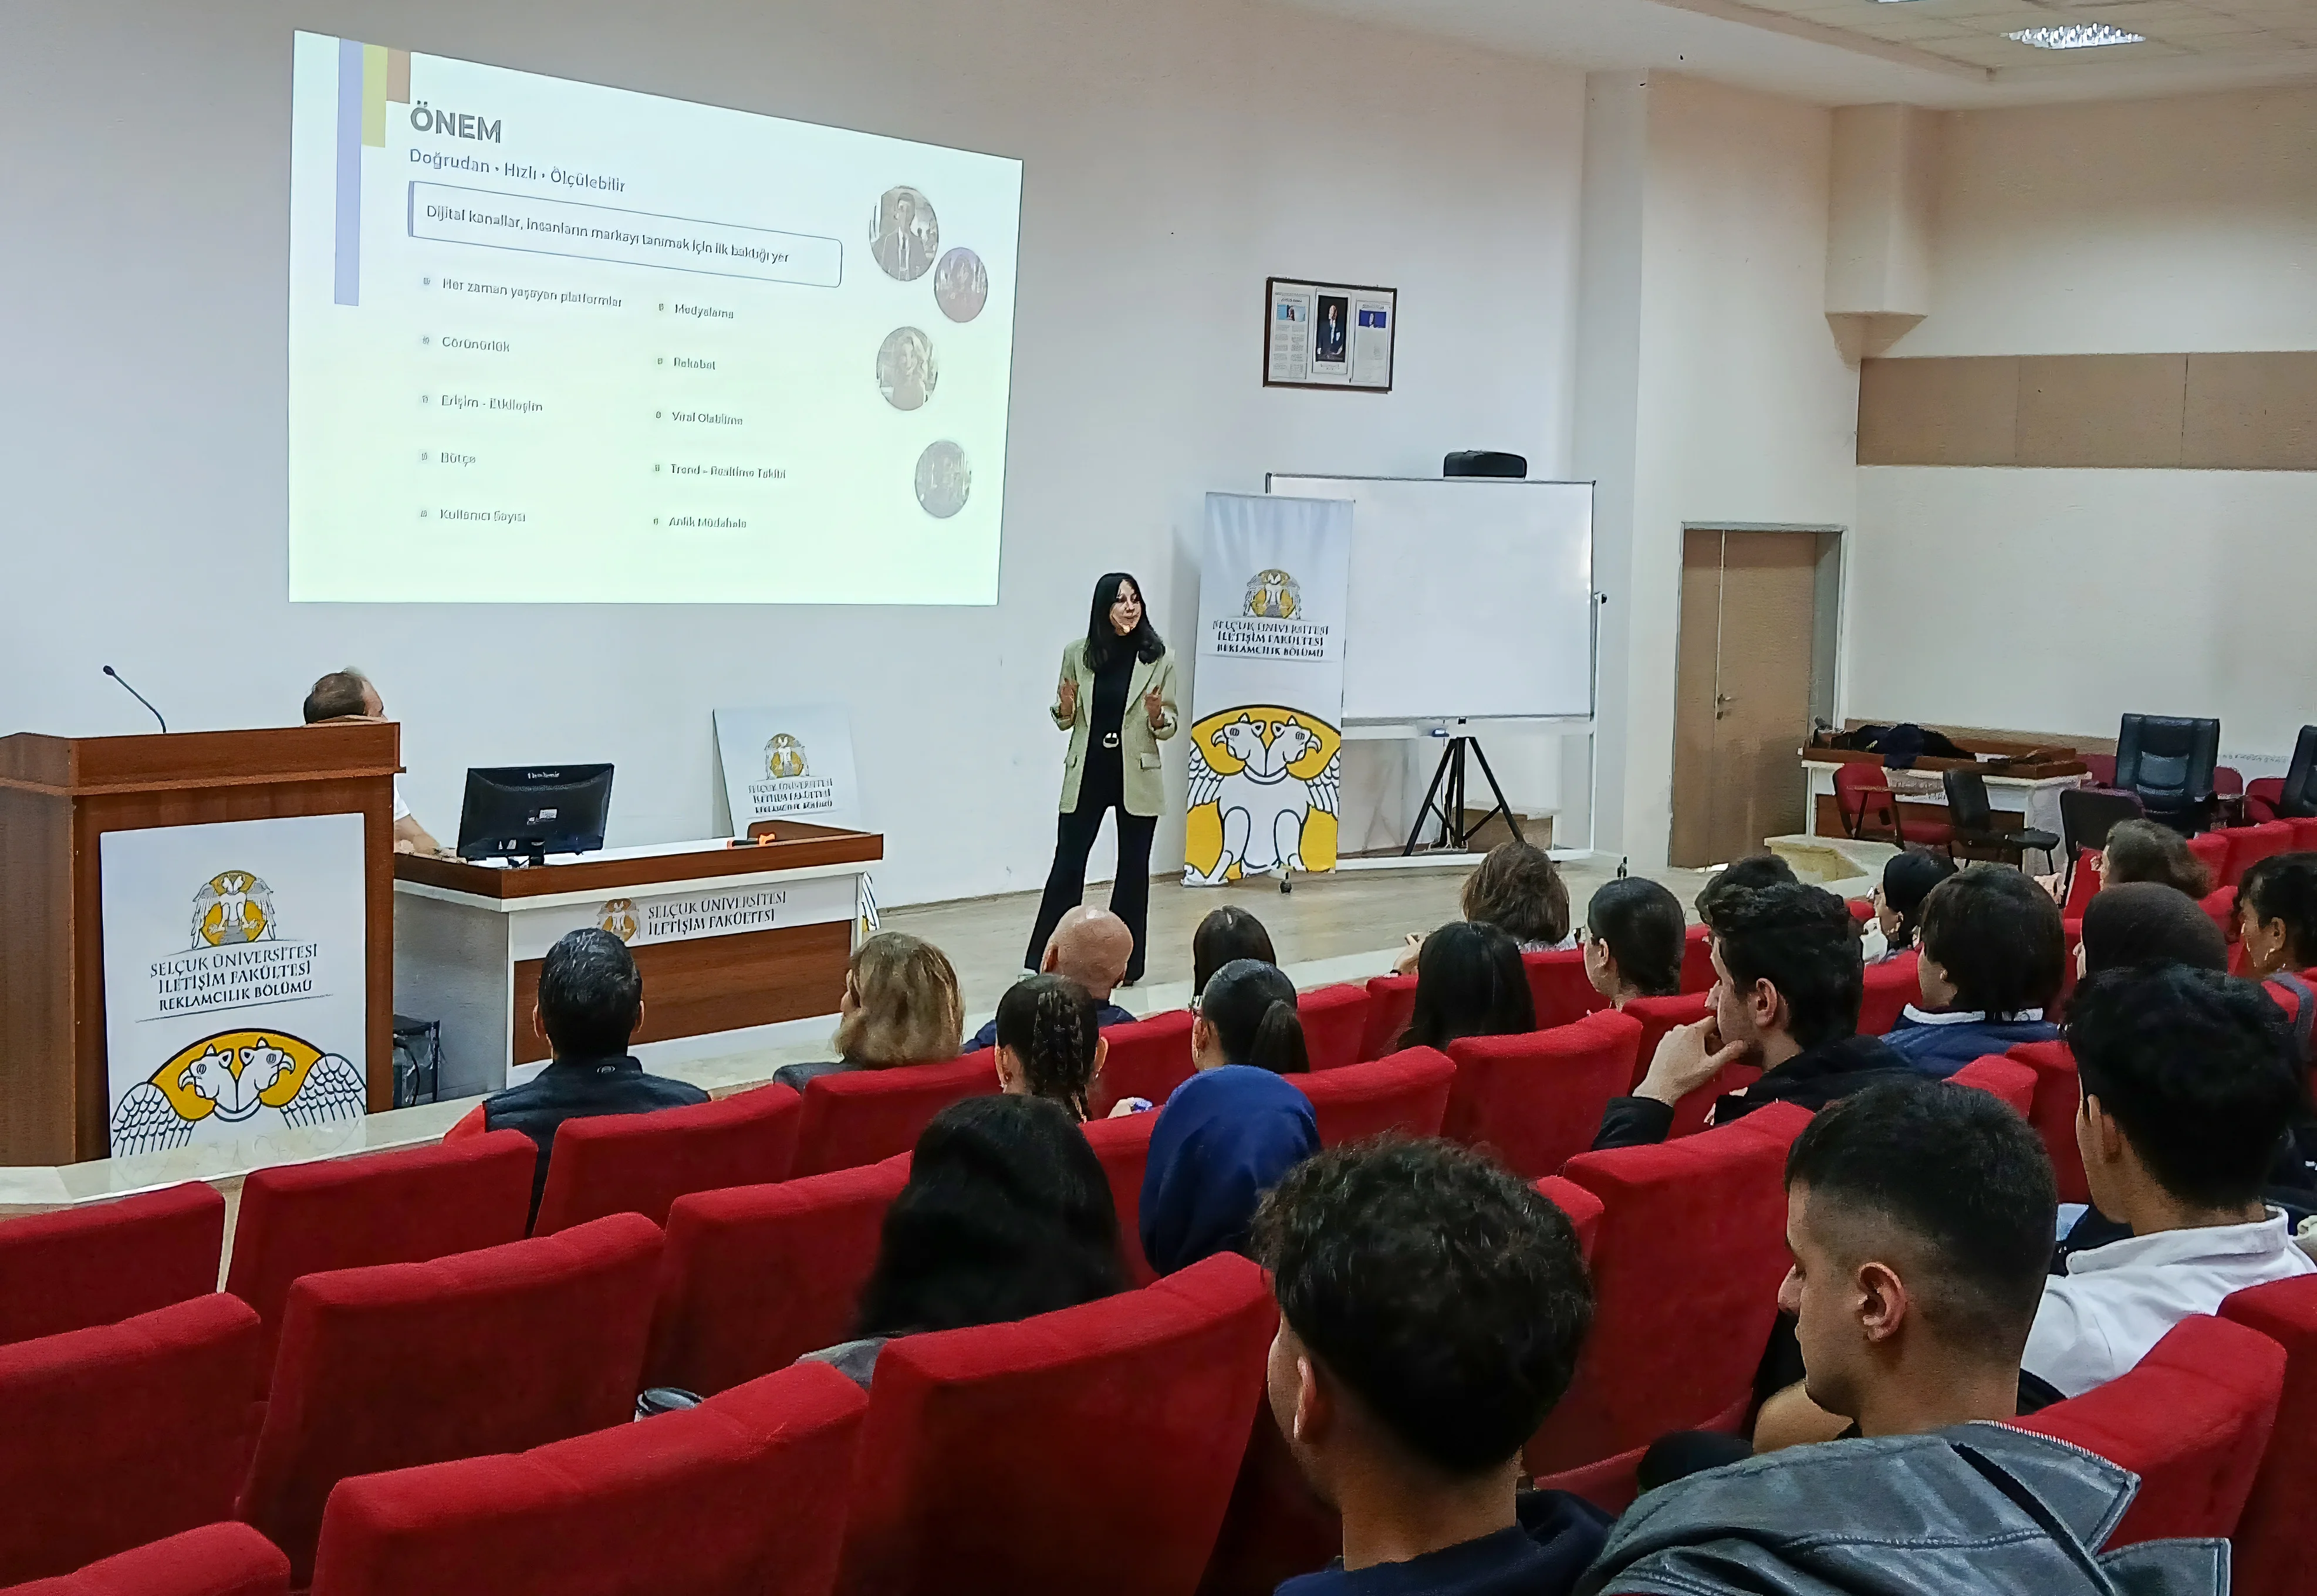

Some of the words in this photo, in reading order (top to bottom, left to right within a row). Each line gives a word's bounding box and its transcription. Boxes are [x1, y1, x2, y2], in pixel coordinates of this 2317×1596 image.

[410, 99, 501, 144] ÖNEM
[410, 148, 489, 173] Doğrudan
[504, 161, 536, 180] Hızlı
[550, 165, 626, 192] Ölçülebilir
[427, 205, 465, 222] Dijital
[469, 209, 523, 231] kanallar,
[591, 229, 639, 245] markayı
[642, 234, 690, 251] tanımak
[692, 239, 712, 255] için
[771, 252, 789, 265] yer
[467, 283, 508, 296] zaman
[560, 291, 622, 307] platformlar
[648, 902, 697, 919] SELÇUK
[649, 917, 705, 935] İLETİŞİM
[150, 956, 208, 978] SELÇUK
[212, 943, 318, 968] ÜNİVERSİTESİ
[158, 972, 225, 994] İLETİŞİM
[230, 960, 310, 985] FAKÜLTESİ
[159, 988, 249, 1011] REKLAMCILIK
[254, 979, 312, 998] BÖLÜMÜ
